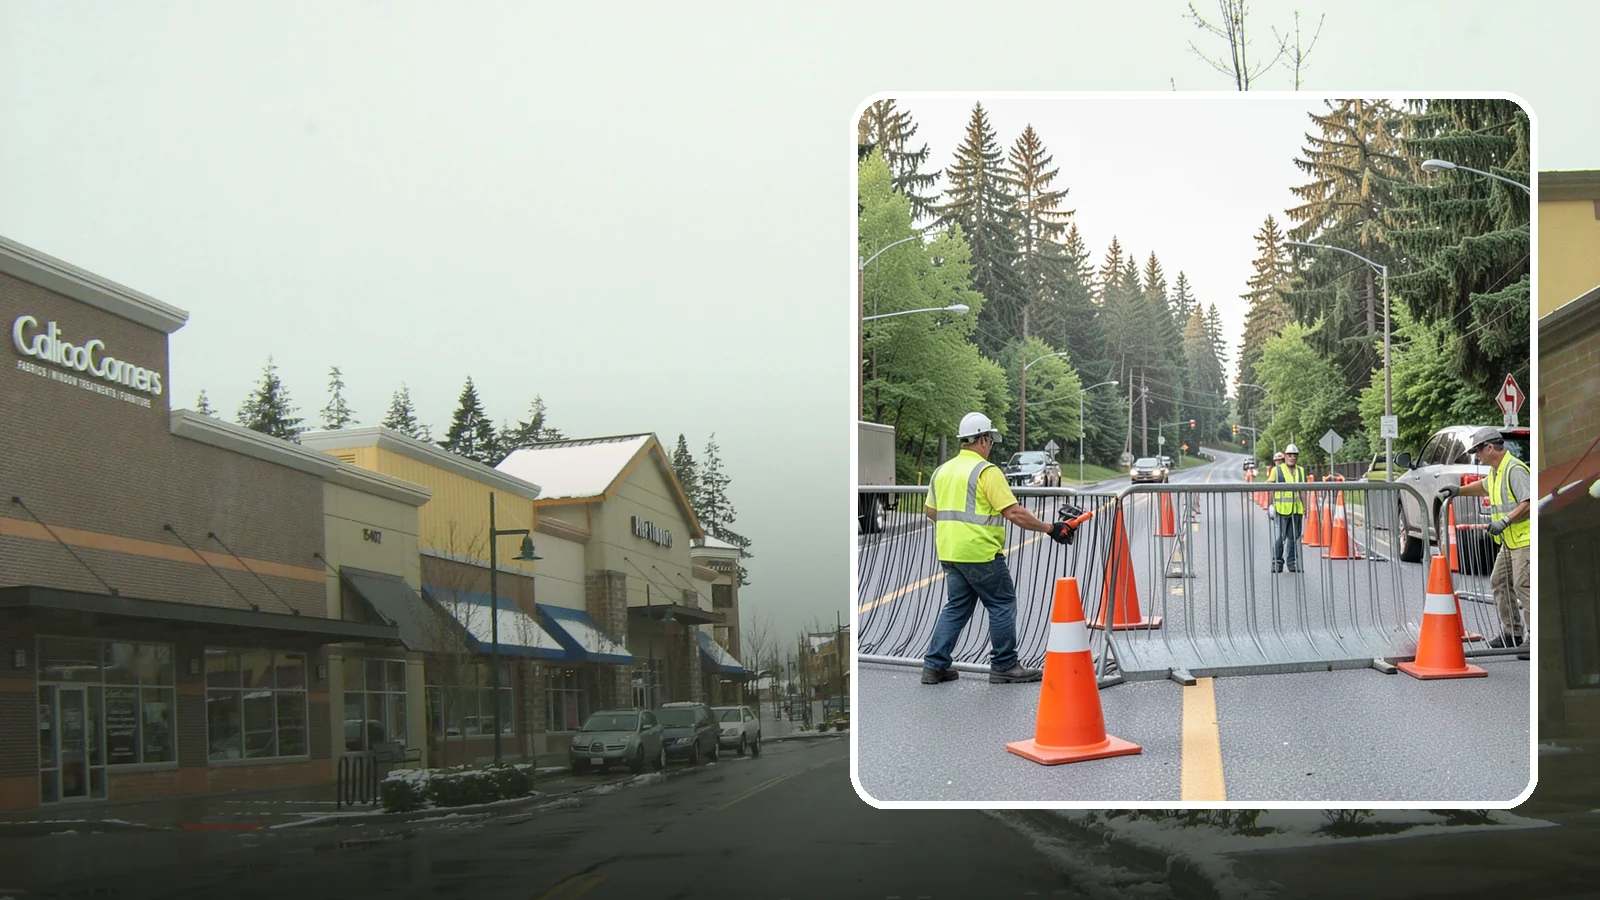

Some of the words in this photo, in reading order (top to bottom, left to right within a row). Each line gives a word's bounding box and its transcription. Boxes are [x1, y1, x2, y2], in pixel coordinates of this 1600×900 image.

[16, 359, 47, 378] FABRICS
[51, 369, 78, 387] WINDOW
[78, 378, 117, 399] TREATMENTS
[120, 391, 151, 409] FURNITURE
